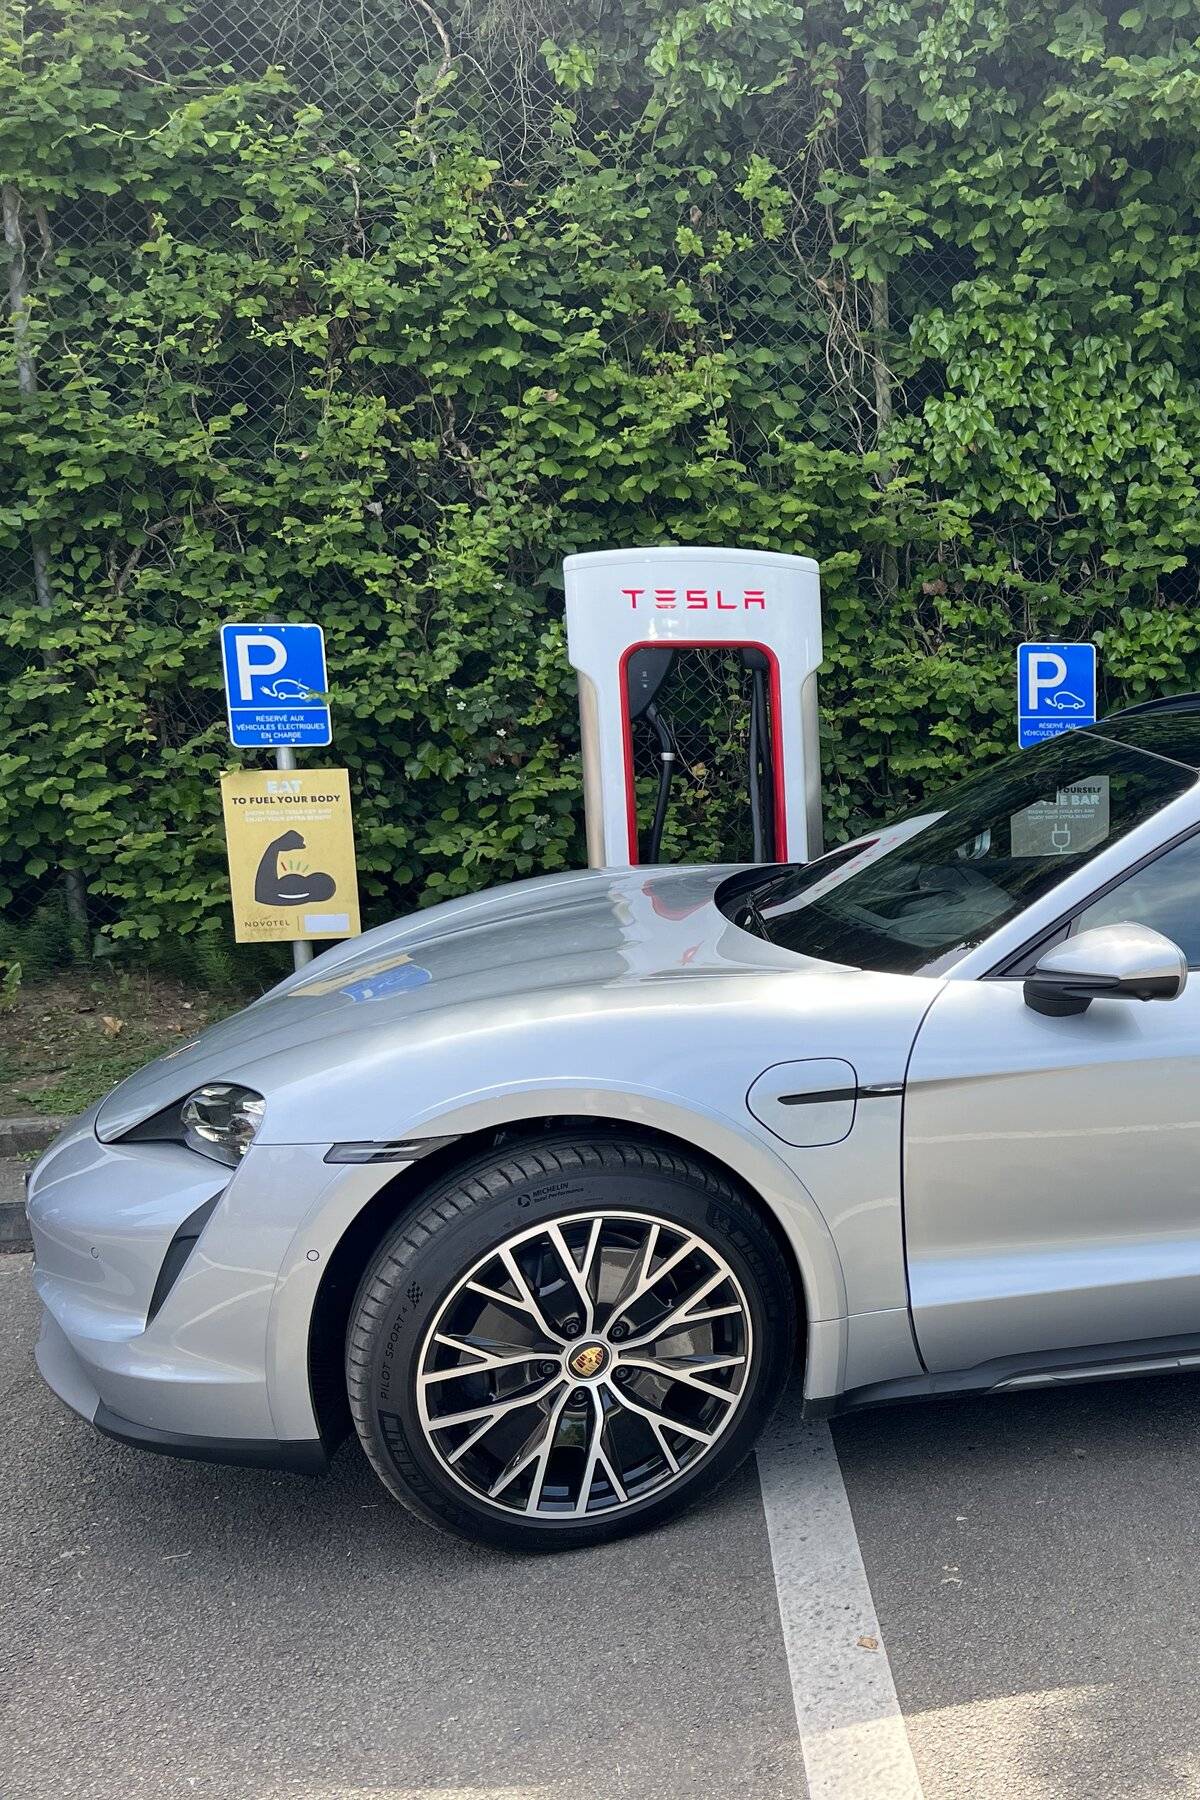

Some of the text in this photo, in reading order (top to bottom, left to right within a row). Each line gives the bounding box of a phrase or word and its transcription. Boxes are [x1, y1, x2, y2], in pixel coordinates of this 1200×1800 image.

[620, 589, 766, 610] TESLA
[235, 634, 288, 701] P
[1028, 652, 1068, 710] P
[266, 779, 303, 794] EAT
[232, 795, 341, 805] TO FUEL YOUR BODY
[1071, 794, 1100, 805] BAR
[244, 919, 291, 928] NOVOTEL
[532, 1181, 569, 1197] MICHELIN
[385, 1314, 405, 1359] SPORT
[380, 1363, 391, 1400] PILOT
